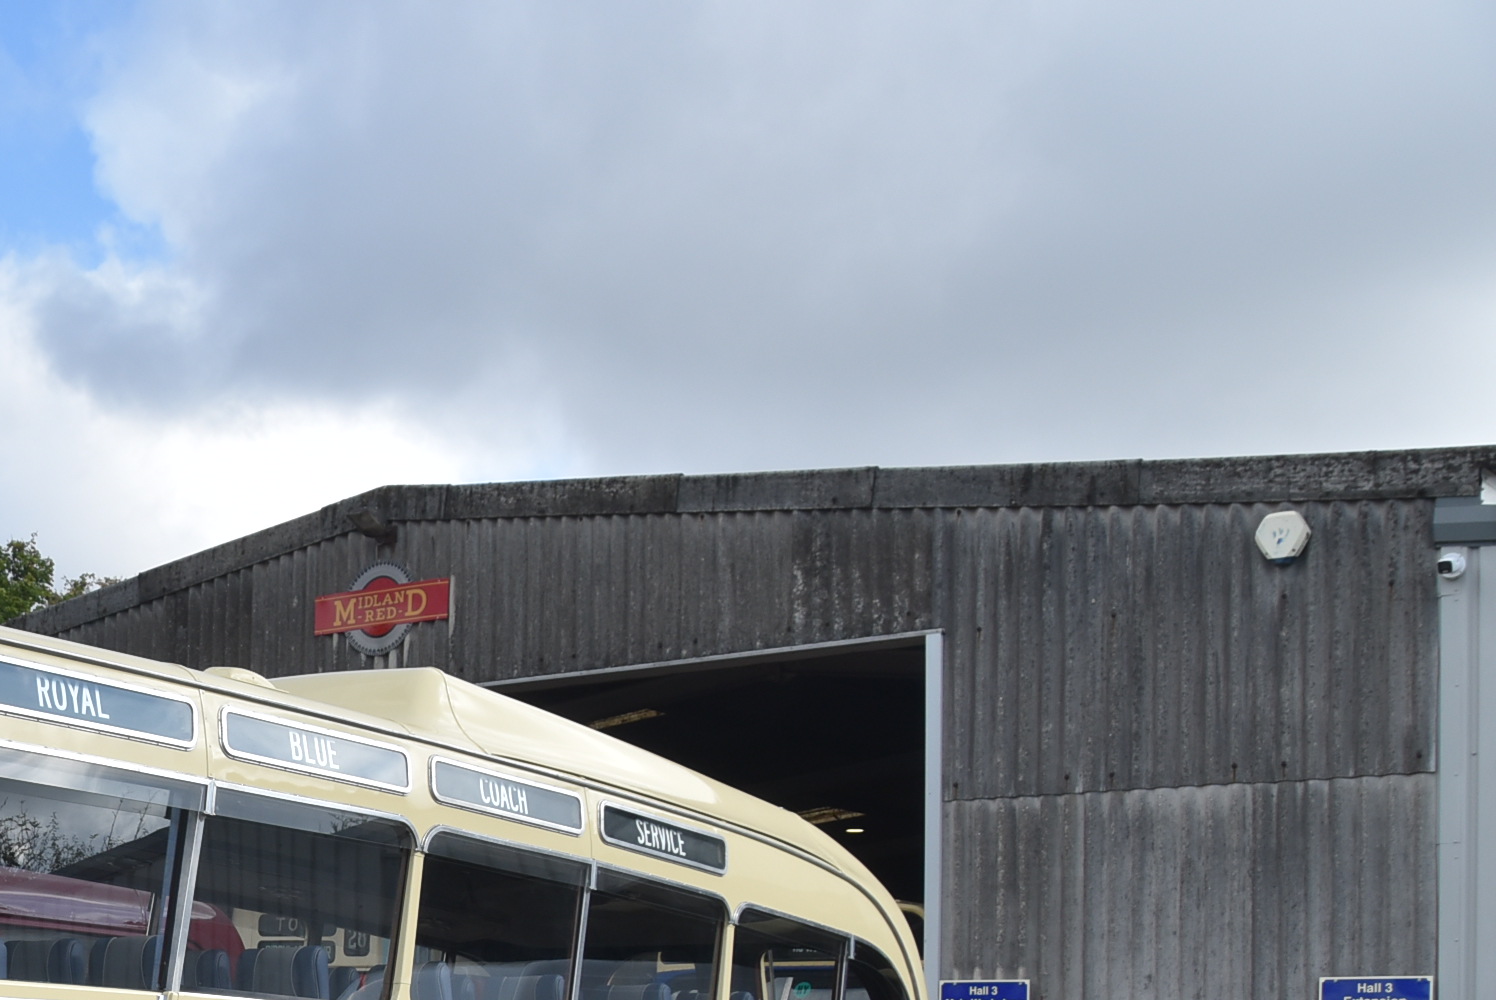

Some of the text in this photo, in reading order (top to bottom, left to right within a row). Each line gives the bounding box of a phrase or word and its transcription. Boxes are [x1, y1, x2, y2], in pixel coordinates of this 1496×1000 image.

[333, 588, 427, 626] MIDLAND
[35, 675, 110, 719] ROYAL
[288, 731, 340, 770] BLUE
[479, 777, 529, 815] COACH
[635, 819, 687, 857] SERVICE
[969, 986, 998, 996] Hall 3
[1357, 983, 1393, 993] Hall 3
